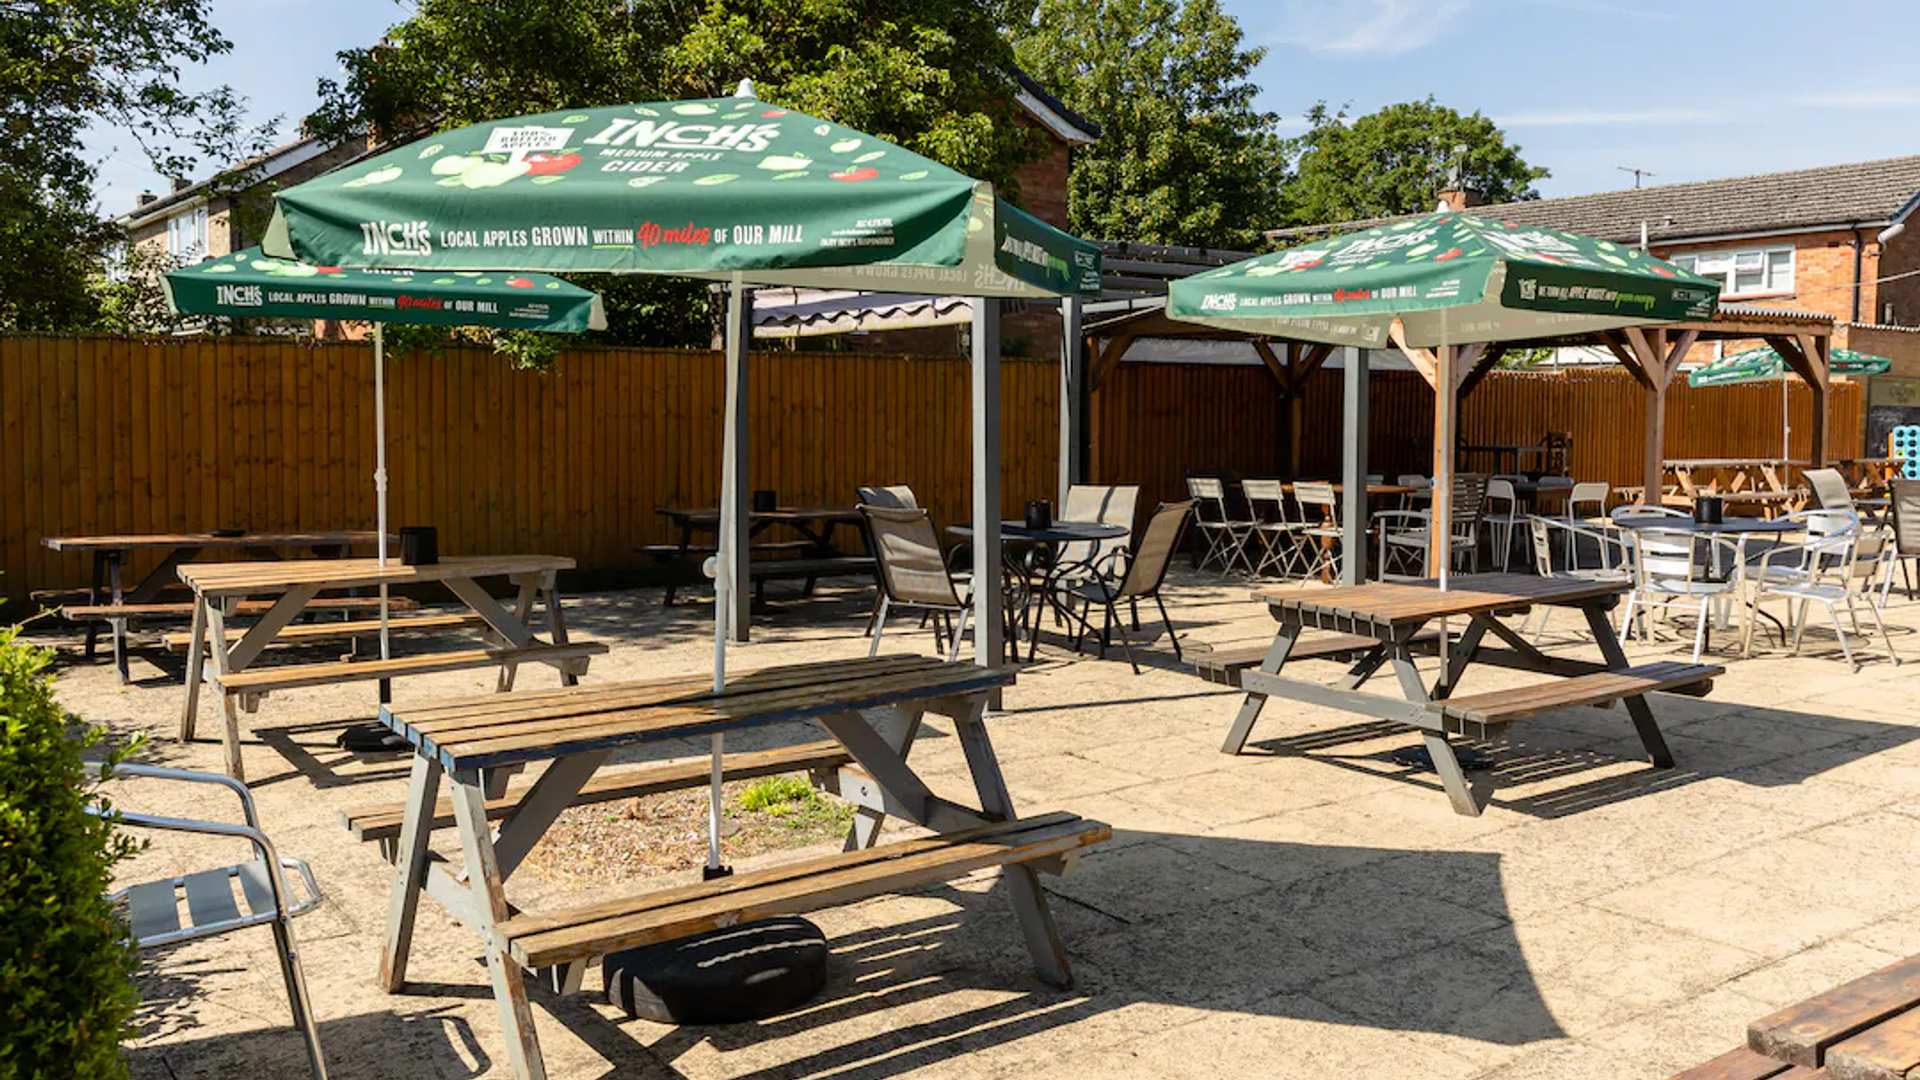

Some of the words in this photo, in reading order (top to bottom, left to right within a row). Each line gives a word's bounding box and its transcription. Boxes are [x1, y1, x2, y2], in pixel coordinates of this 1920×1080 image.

[599, 149, 667, 159] MEDIUM
[670, 152, 724, 161] APPLE
[601, 160, 690, 173] CIDER
[440, 230, 479, 247] LOCAL
[483, 230, 527, 247] APPLES
[531, 226, 588, 246] GROWN
[592, 229, 634, 245] WITHIN
[636, 220, 662, 250] 40
[662, 220, 712, 246] miles
[714, 228, 728, 244] OF
[733, 225, 763, 245] OUR
[768, 224, 803, 244] MILL
[268, 291, 294, 303] LOCAL
[297, 293, 327, 304] APPLES
[329, 293, 366, 306] GROWN
[455, 301, 475, 311] OUR
[477, 301, 498, 313] MILL
[1240, 297, 1258, 306] LOCAL
[1260, 296, 1281, 306] APPLES
[1284, 293, 1311, 305] GROWN
[1381, 287, 1397, 299] OUR
[1399, 285, 1417, 298] MILL
